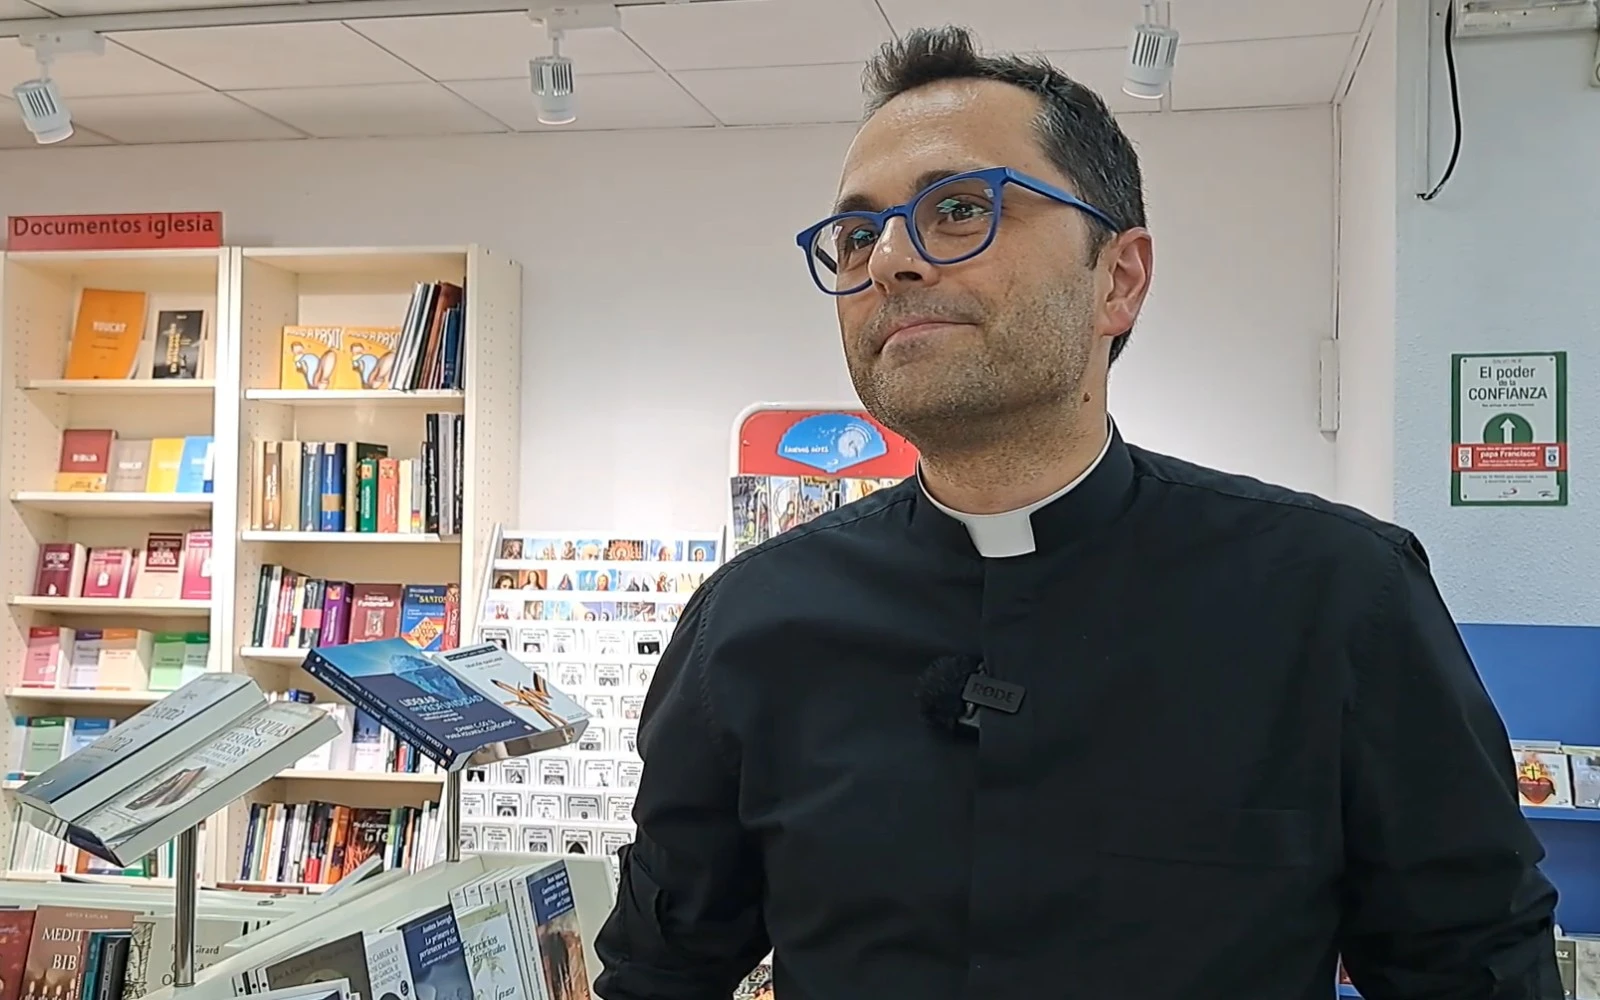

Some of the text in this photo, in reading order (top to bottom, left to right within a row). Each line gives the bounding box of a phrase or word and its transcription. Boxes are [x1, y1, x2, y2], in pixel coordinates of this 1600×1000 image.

[14, 212, 214, 239] Documentos iglesia
[1480, 365, 1536, 381] El poder
[1468, 387, 1548, 401] CONFIANZA
[1480, 451, 1498, 459] papa
[461, 934, 498, 957] Ejercicios
[472, 943, 506, 964] Espirituales
[52, 954, 77, 970] BIB
